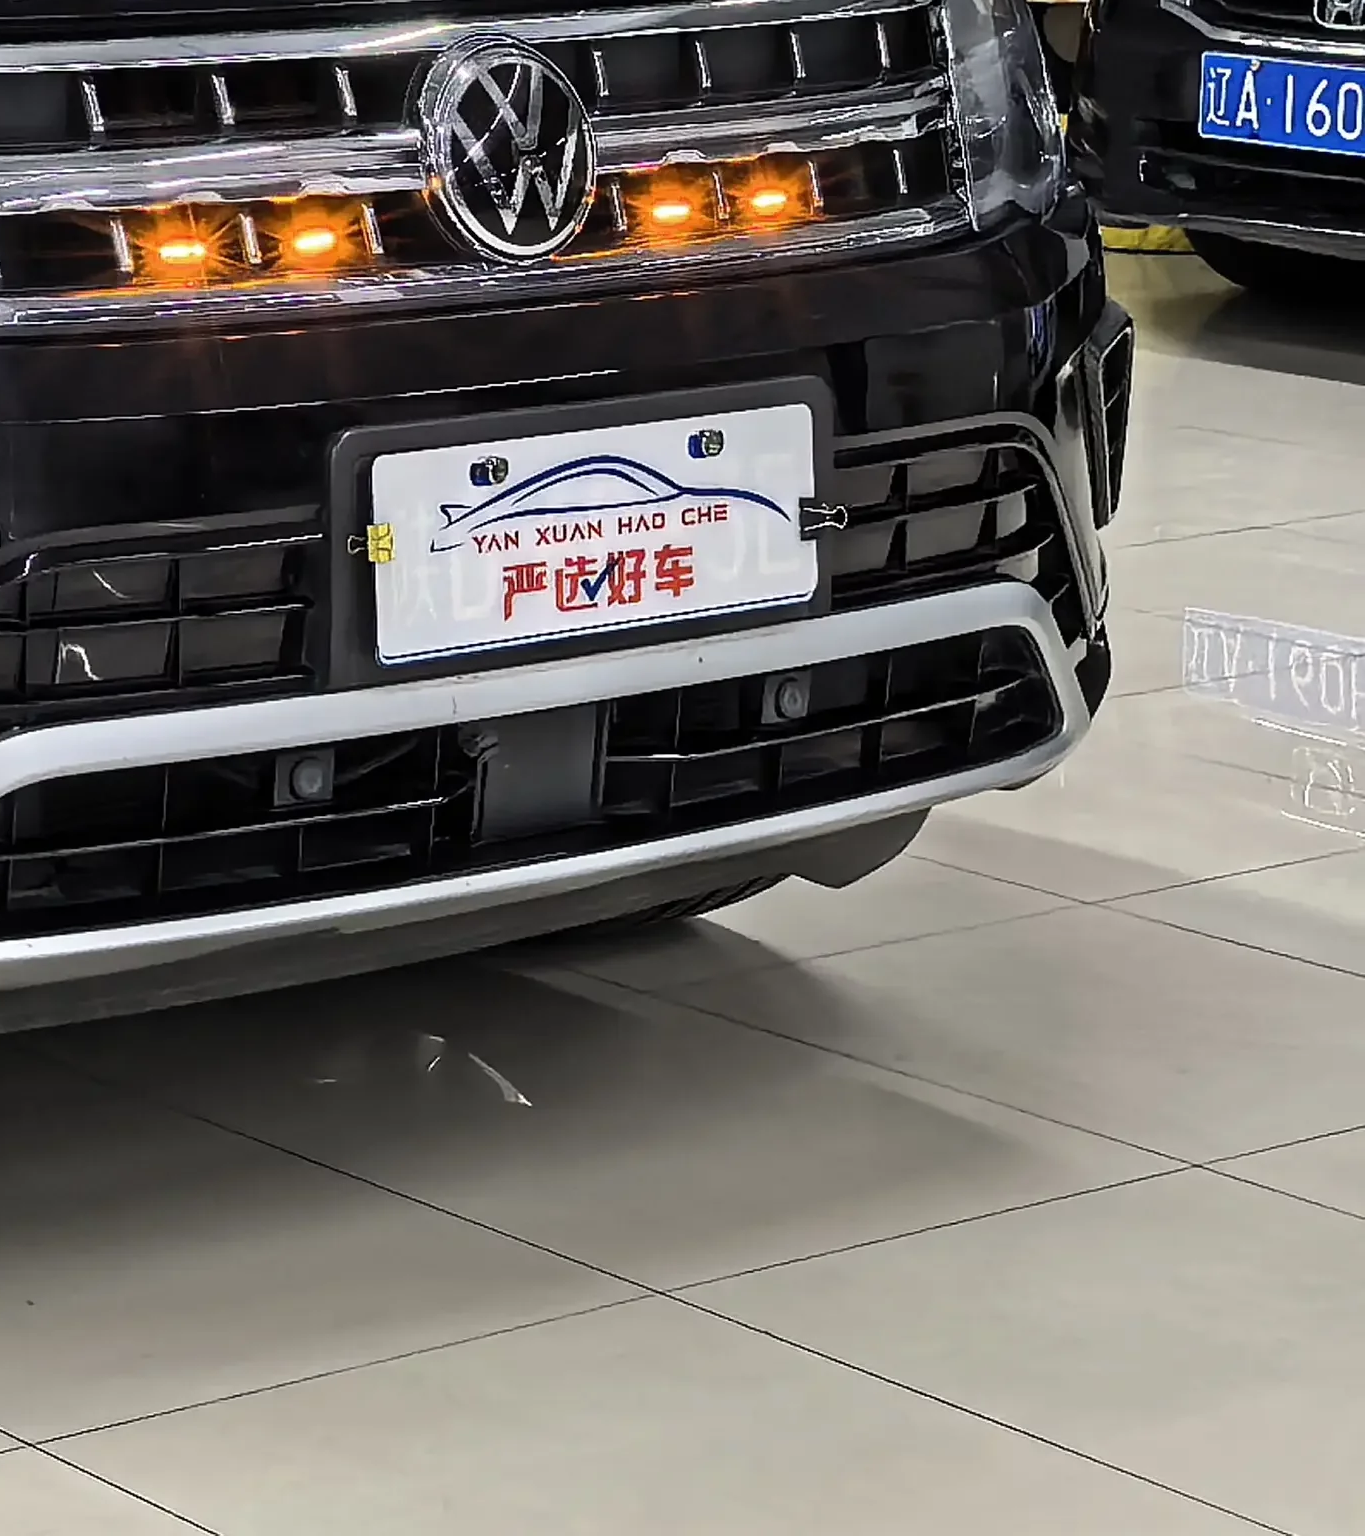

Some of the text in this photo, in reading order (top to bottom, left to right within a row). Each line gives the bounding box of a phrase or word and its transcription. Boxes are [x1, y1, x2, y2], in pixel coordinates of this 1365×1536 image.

[472, 504, 730, 554] YAN XUAN HAO CHE
[501, 543, 696, 623] 严选好车
